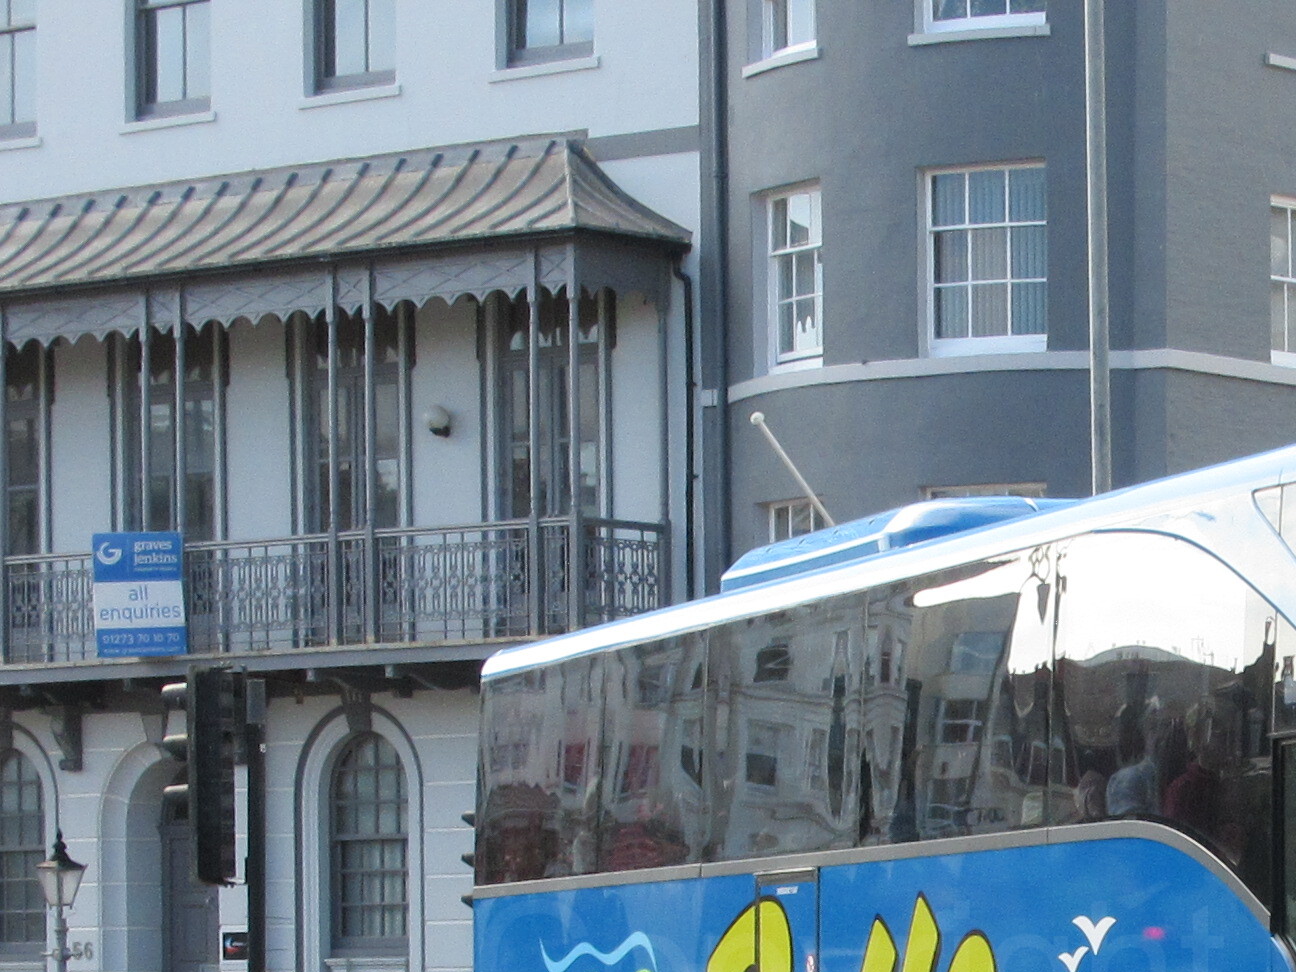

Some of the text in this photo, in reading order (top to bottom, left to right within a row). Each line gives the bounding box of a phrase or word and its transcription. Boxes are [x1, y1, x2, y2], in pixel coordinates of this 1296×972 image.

[134, 541, 172, 552] graves
[134, 553, 178, 565] jenkins
[128, 585, 148, 600] all
[100, 602, 181, 623] enquiries
